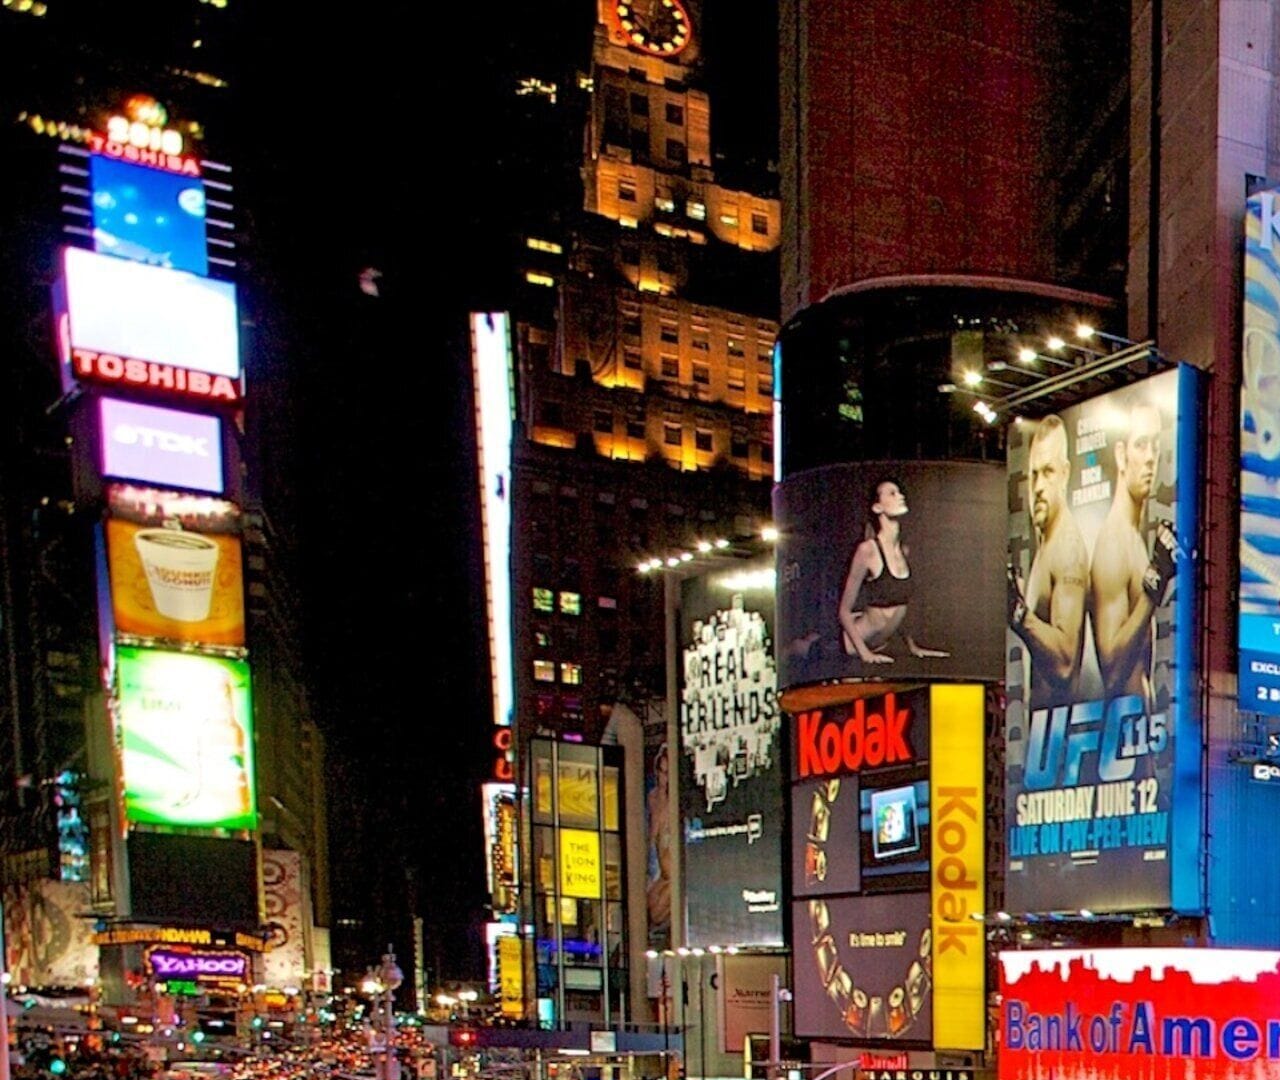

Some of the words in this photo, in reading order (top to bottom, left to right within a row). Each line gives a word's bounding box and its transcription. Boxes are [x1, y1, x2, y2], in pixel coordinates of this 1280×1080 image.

[89, 136, 200, 176] TOSHIBA
[73, 350, 237, 400] TOSHIBA
[701, 647, 747, 688] REAL
[686, 687, 775, 734] FRIENDS
[1257, 686, 1268, 700] 2
[797, 692, 911, 777] Kodak
[1024, 694, 1144, 790] UFC
[1121, 713, 1168, 757] 115
[1016, 785, 1096, 827] SATURDAY
[1095, 781, 1136, 818] JUNE
[1137, 777, 1159, 814] 12
[569, 842, 590, 853] THE
[1010, 823, 1039, 858] LIVE
[1062, 812, 1169, 852] PAY-PER-VIEW
[566, 854, 595, 868] LION
[566, 872, 596, 887] KING
[936, 786, 978, 956] Kodak
[152, 955, 244, 973] YAHOO!
[1005, 999, 1083, 1053] Bank
[1089, 1002, 1123, 1051] of
